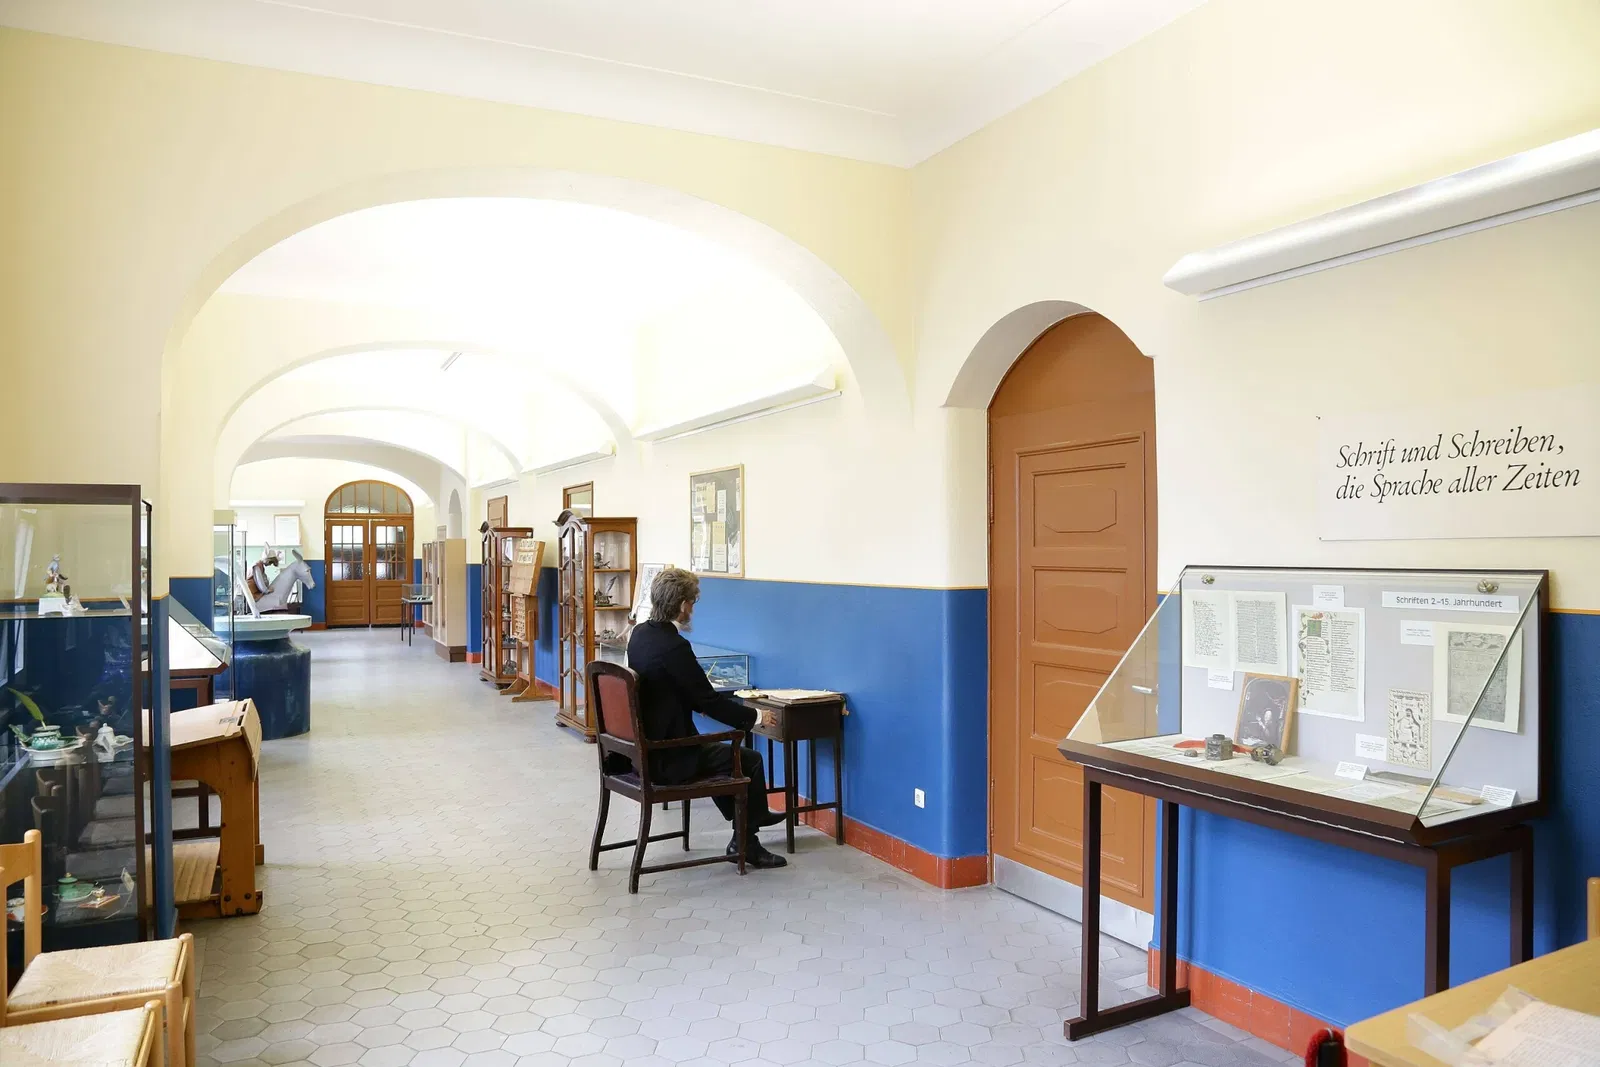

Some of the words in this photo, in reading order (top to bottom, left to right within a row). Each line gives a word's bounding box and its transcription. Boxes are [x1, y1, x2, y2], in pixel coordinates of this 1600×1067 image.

[1336, 438, 1396, 471] Schrift
[1400, 433, 1443, 464] und
[1447, 425, 1565, 460] Schreiben,
[1335, 474, 1365, 500] die
[1369, 468, 1443, 504] Sprache
[1447, 465, 1498, 494] aller
[1501, 461, 1581, 492] Zeiten
[1396, 596, 1429, 605] Schriften
[1453, 598, 1502, 607] Jahrhundert
